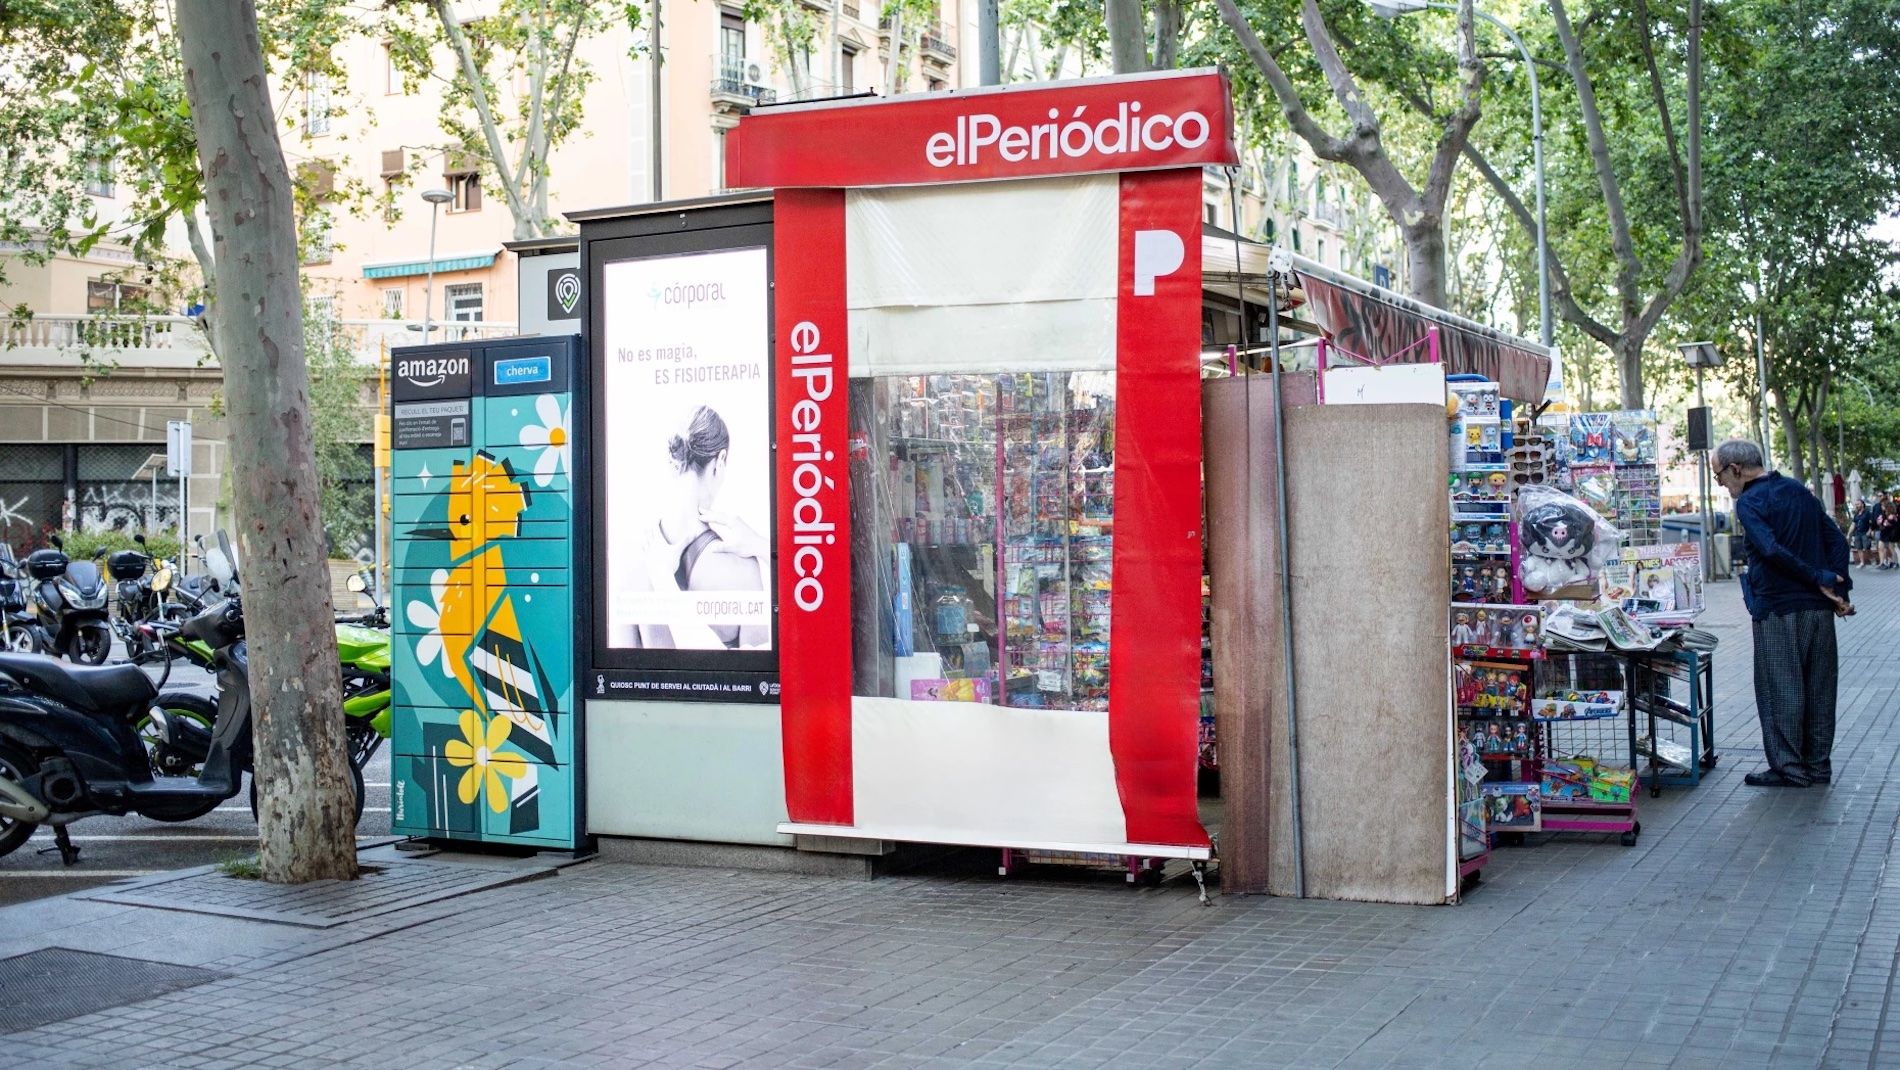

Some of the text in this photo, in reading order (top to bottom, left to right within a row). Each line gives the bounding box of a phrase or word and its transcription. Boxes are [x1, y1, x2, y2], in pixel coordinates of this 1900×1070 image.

[925, 100, 1211, 168] elPeriódico
[1133, 229, 1186, 296] P
[618, 347, 633, 363] No
[638, 350, 652, 361] es
[398, 358, 469, 377] amazon
[506, 366, 539, 377] cherva
[655, 363, 761, 384] ES FISIOTERAPIA
[790, 320, 837, 612] elPeriódico
[692, 683, 718, 691] CIUTADÀ
